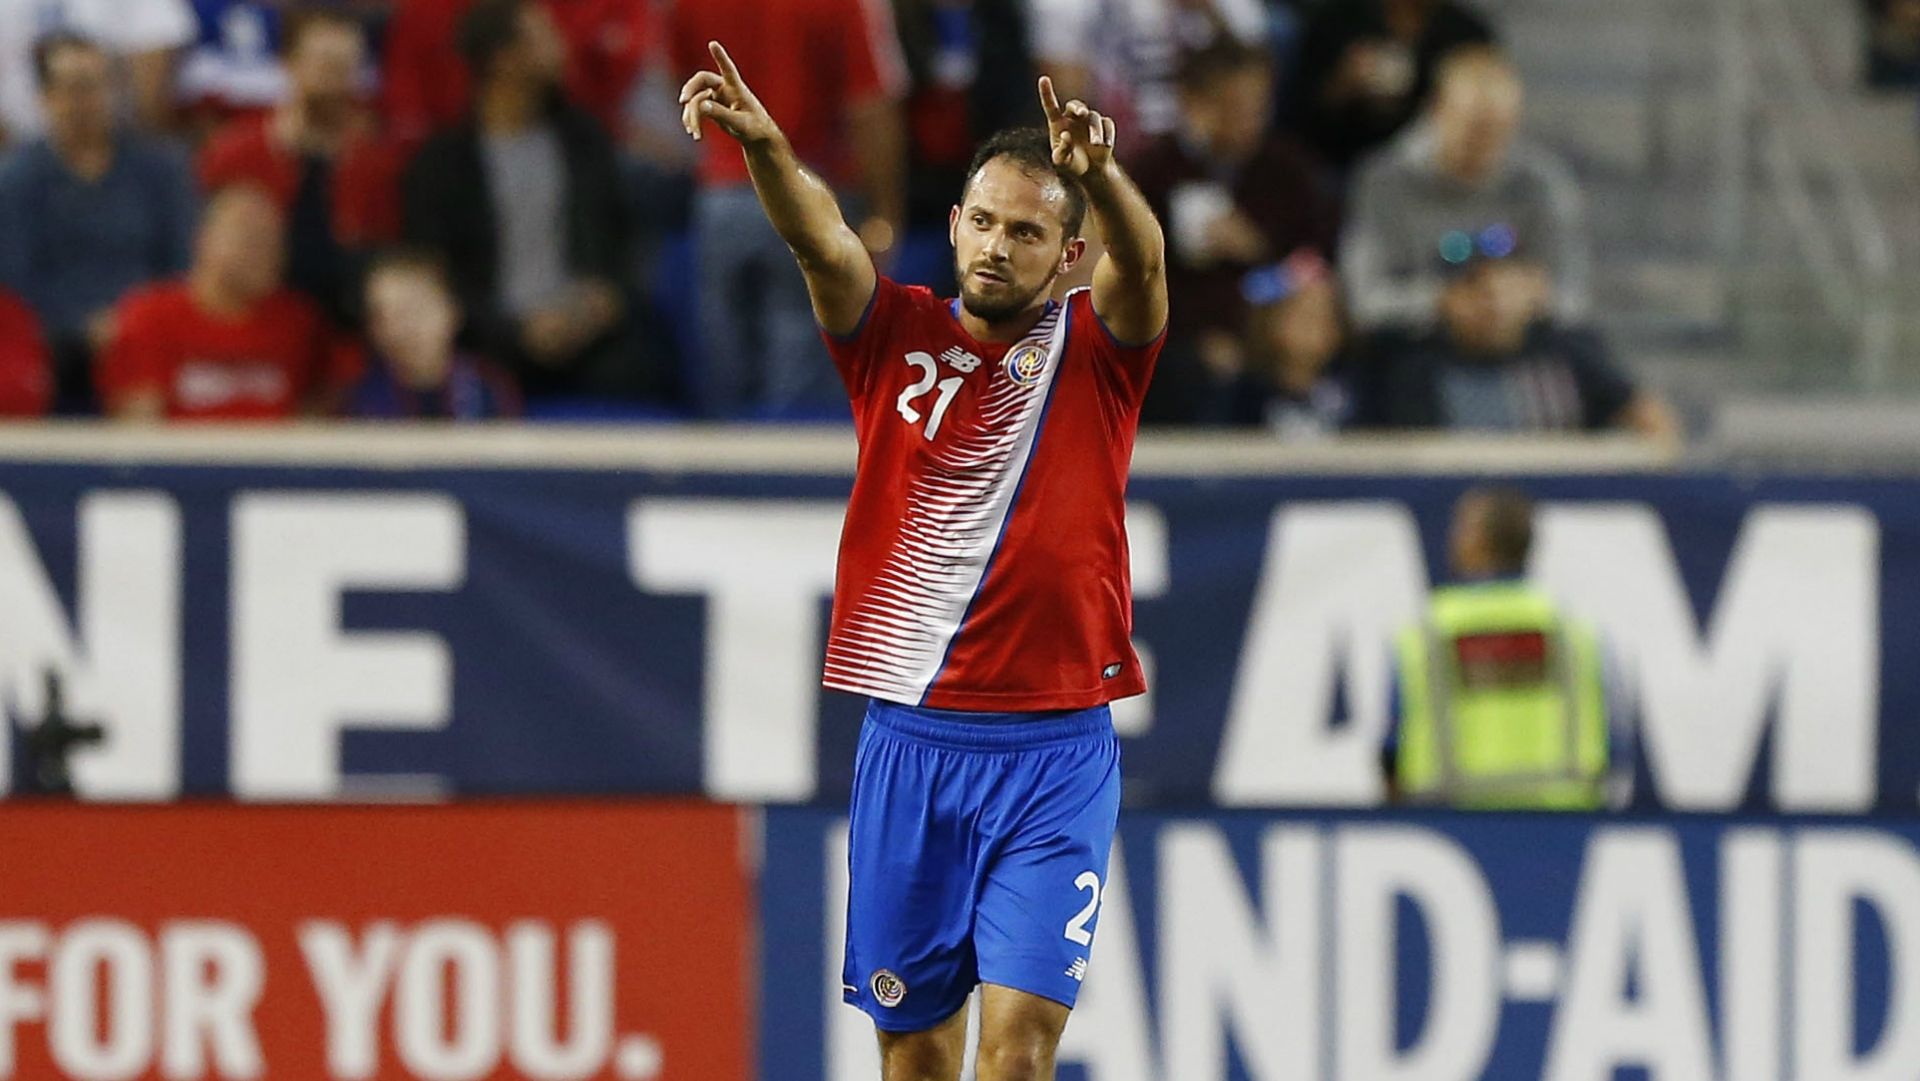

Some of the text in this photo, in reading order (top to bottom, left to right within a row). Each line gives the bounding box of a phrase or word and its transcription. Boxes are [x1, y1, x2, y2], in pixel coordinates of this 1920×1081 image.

[896, 351, 964, 442] 21
[627, 496, 1881, 813] TAM
[1064, 870, 1103, 947] 2
[298, 917, 662, 1081] YOU.
